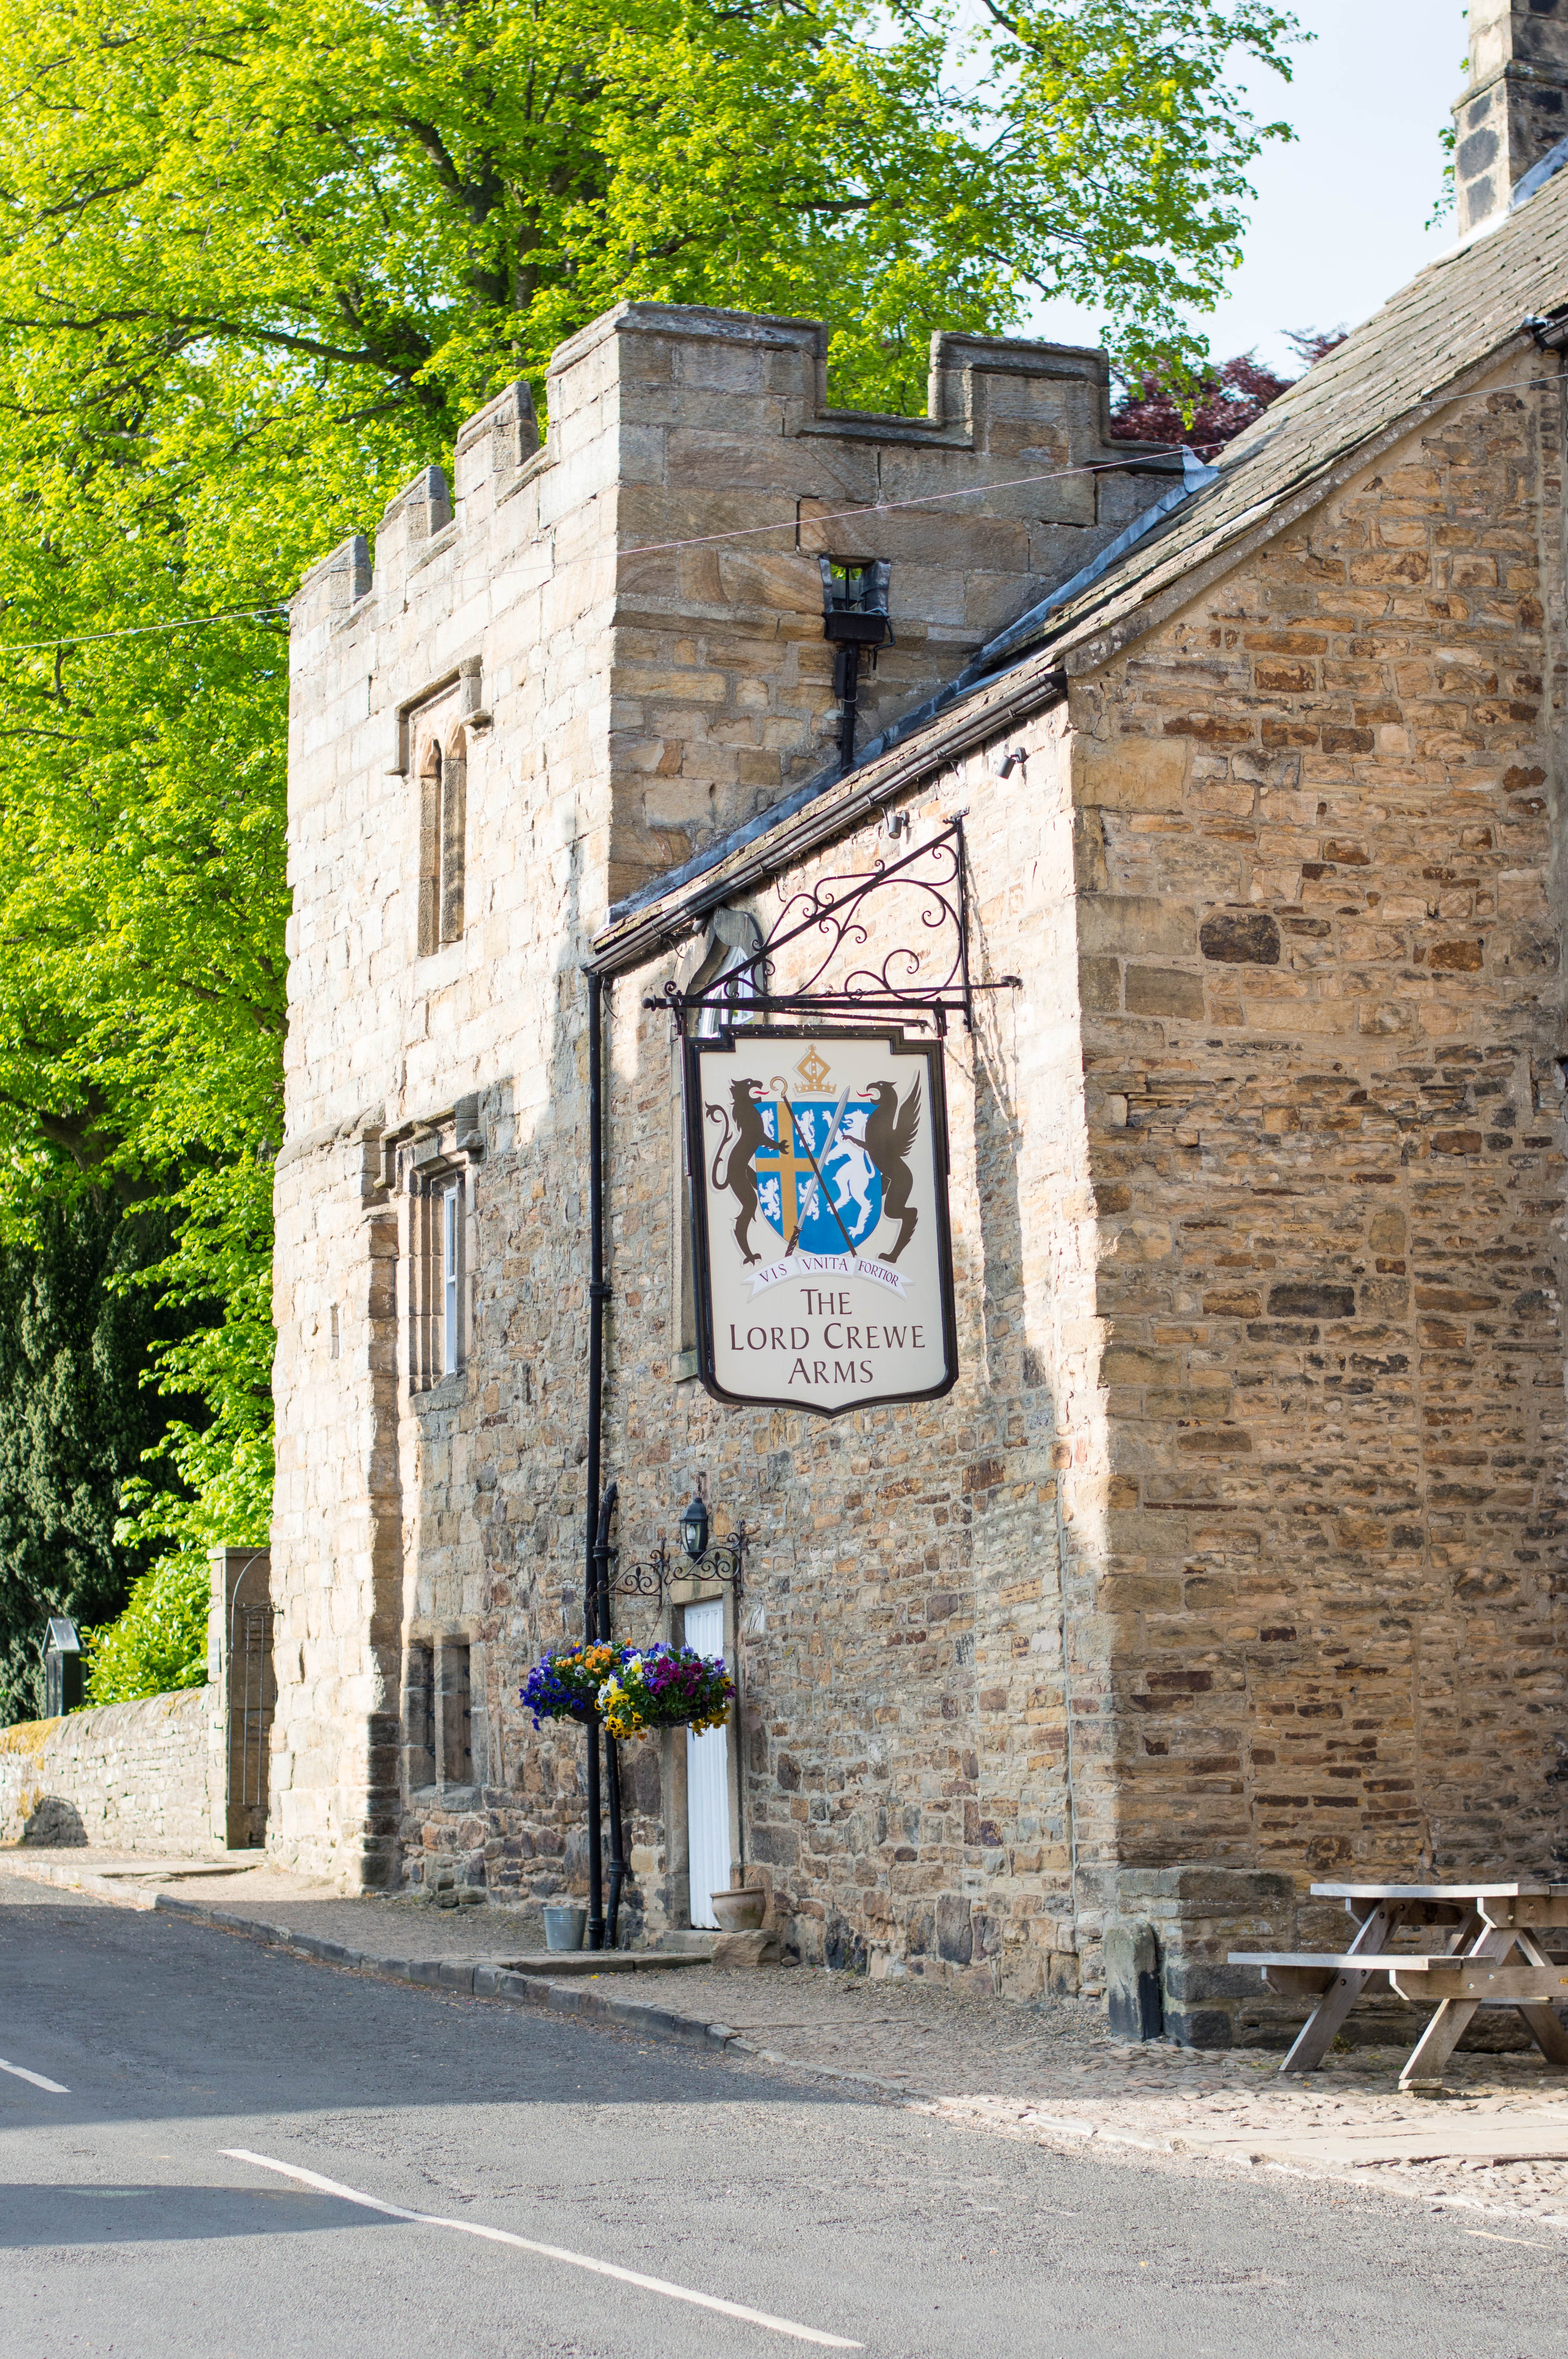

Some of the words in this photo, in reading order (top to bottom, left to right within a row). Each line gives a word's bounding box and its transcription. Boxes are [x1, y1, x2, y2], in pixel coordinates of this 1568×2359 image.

[759, 1264, 787, 1283] VIS
[858, 1260, 898, 1287] FORTIOR
[800, 1289, 852, 1315] THE
[730, 1324, 809, 1350] LORD
[824, 1323, 925, 1349] CREWE
[788, 1358, 873, 1384] ARMS
